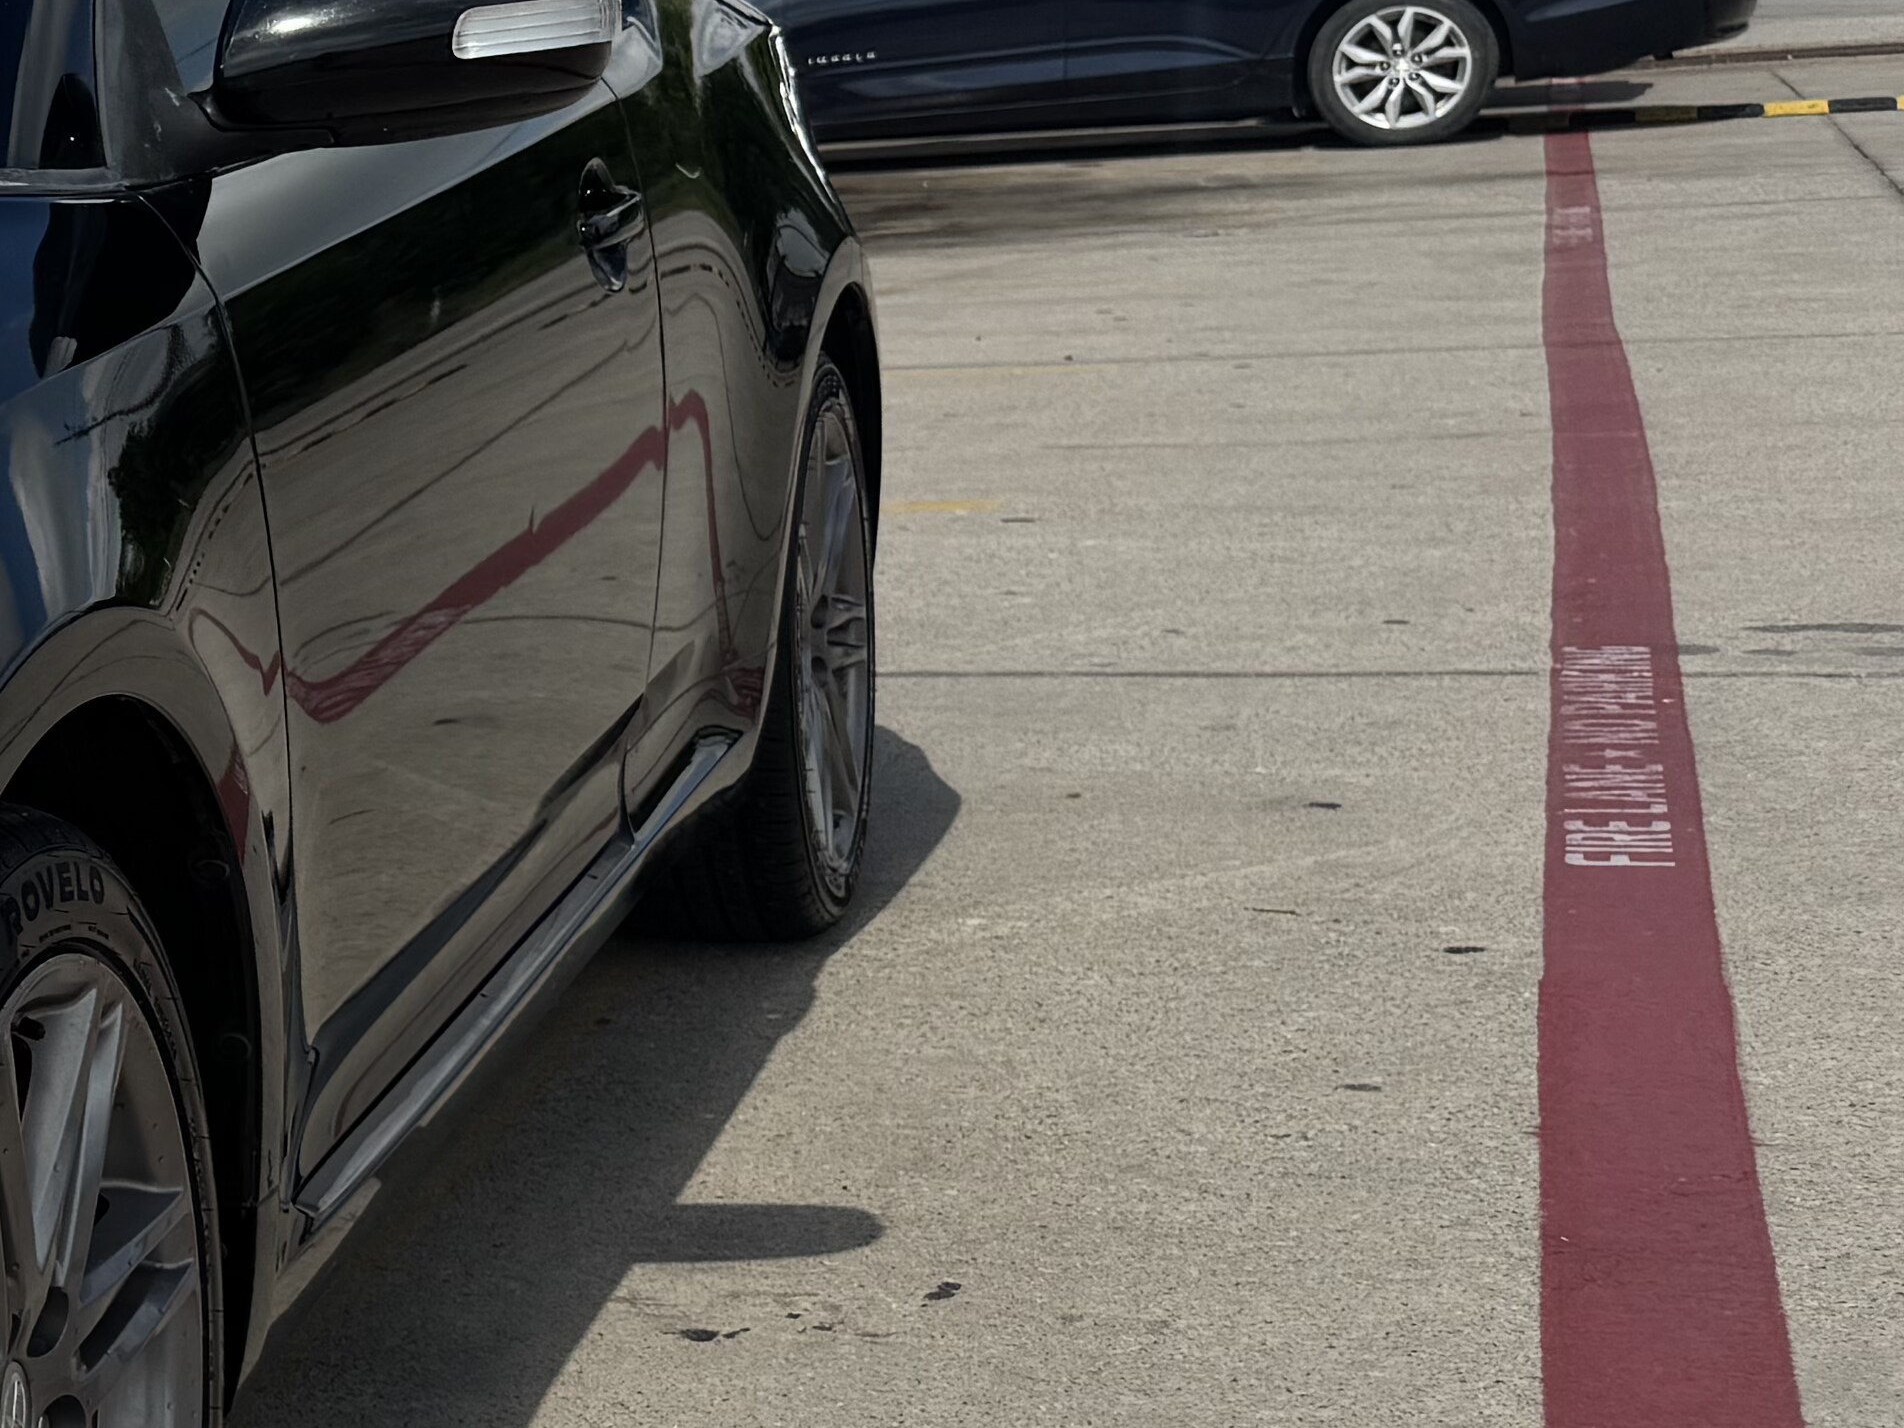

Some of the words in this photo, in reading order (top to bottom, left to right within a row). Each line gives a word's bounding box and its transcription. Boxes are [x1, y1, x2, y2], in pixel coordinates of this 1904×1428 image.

[1559, 645, 1657, 715] PARKING
[1563, 719, 1660, 744] NO
[1563, 763, 1668, 813] LANE
[1563, 820, 1676, 867] FIRE
[0, 861, 105, 946] ROVELO
